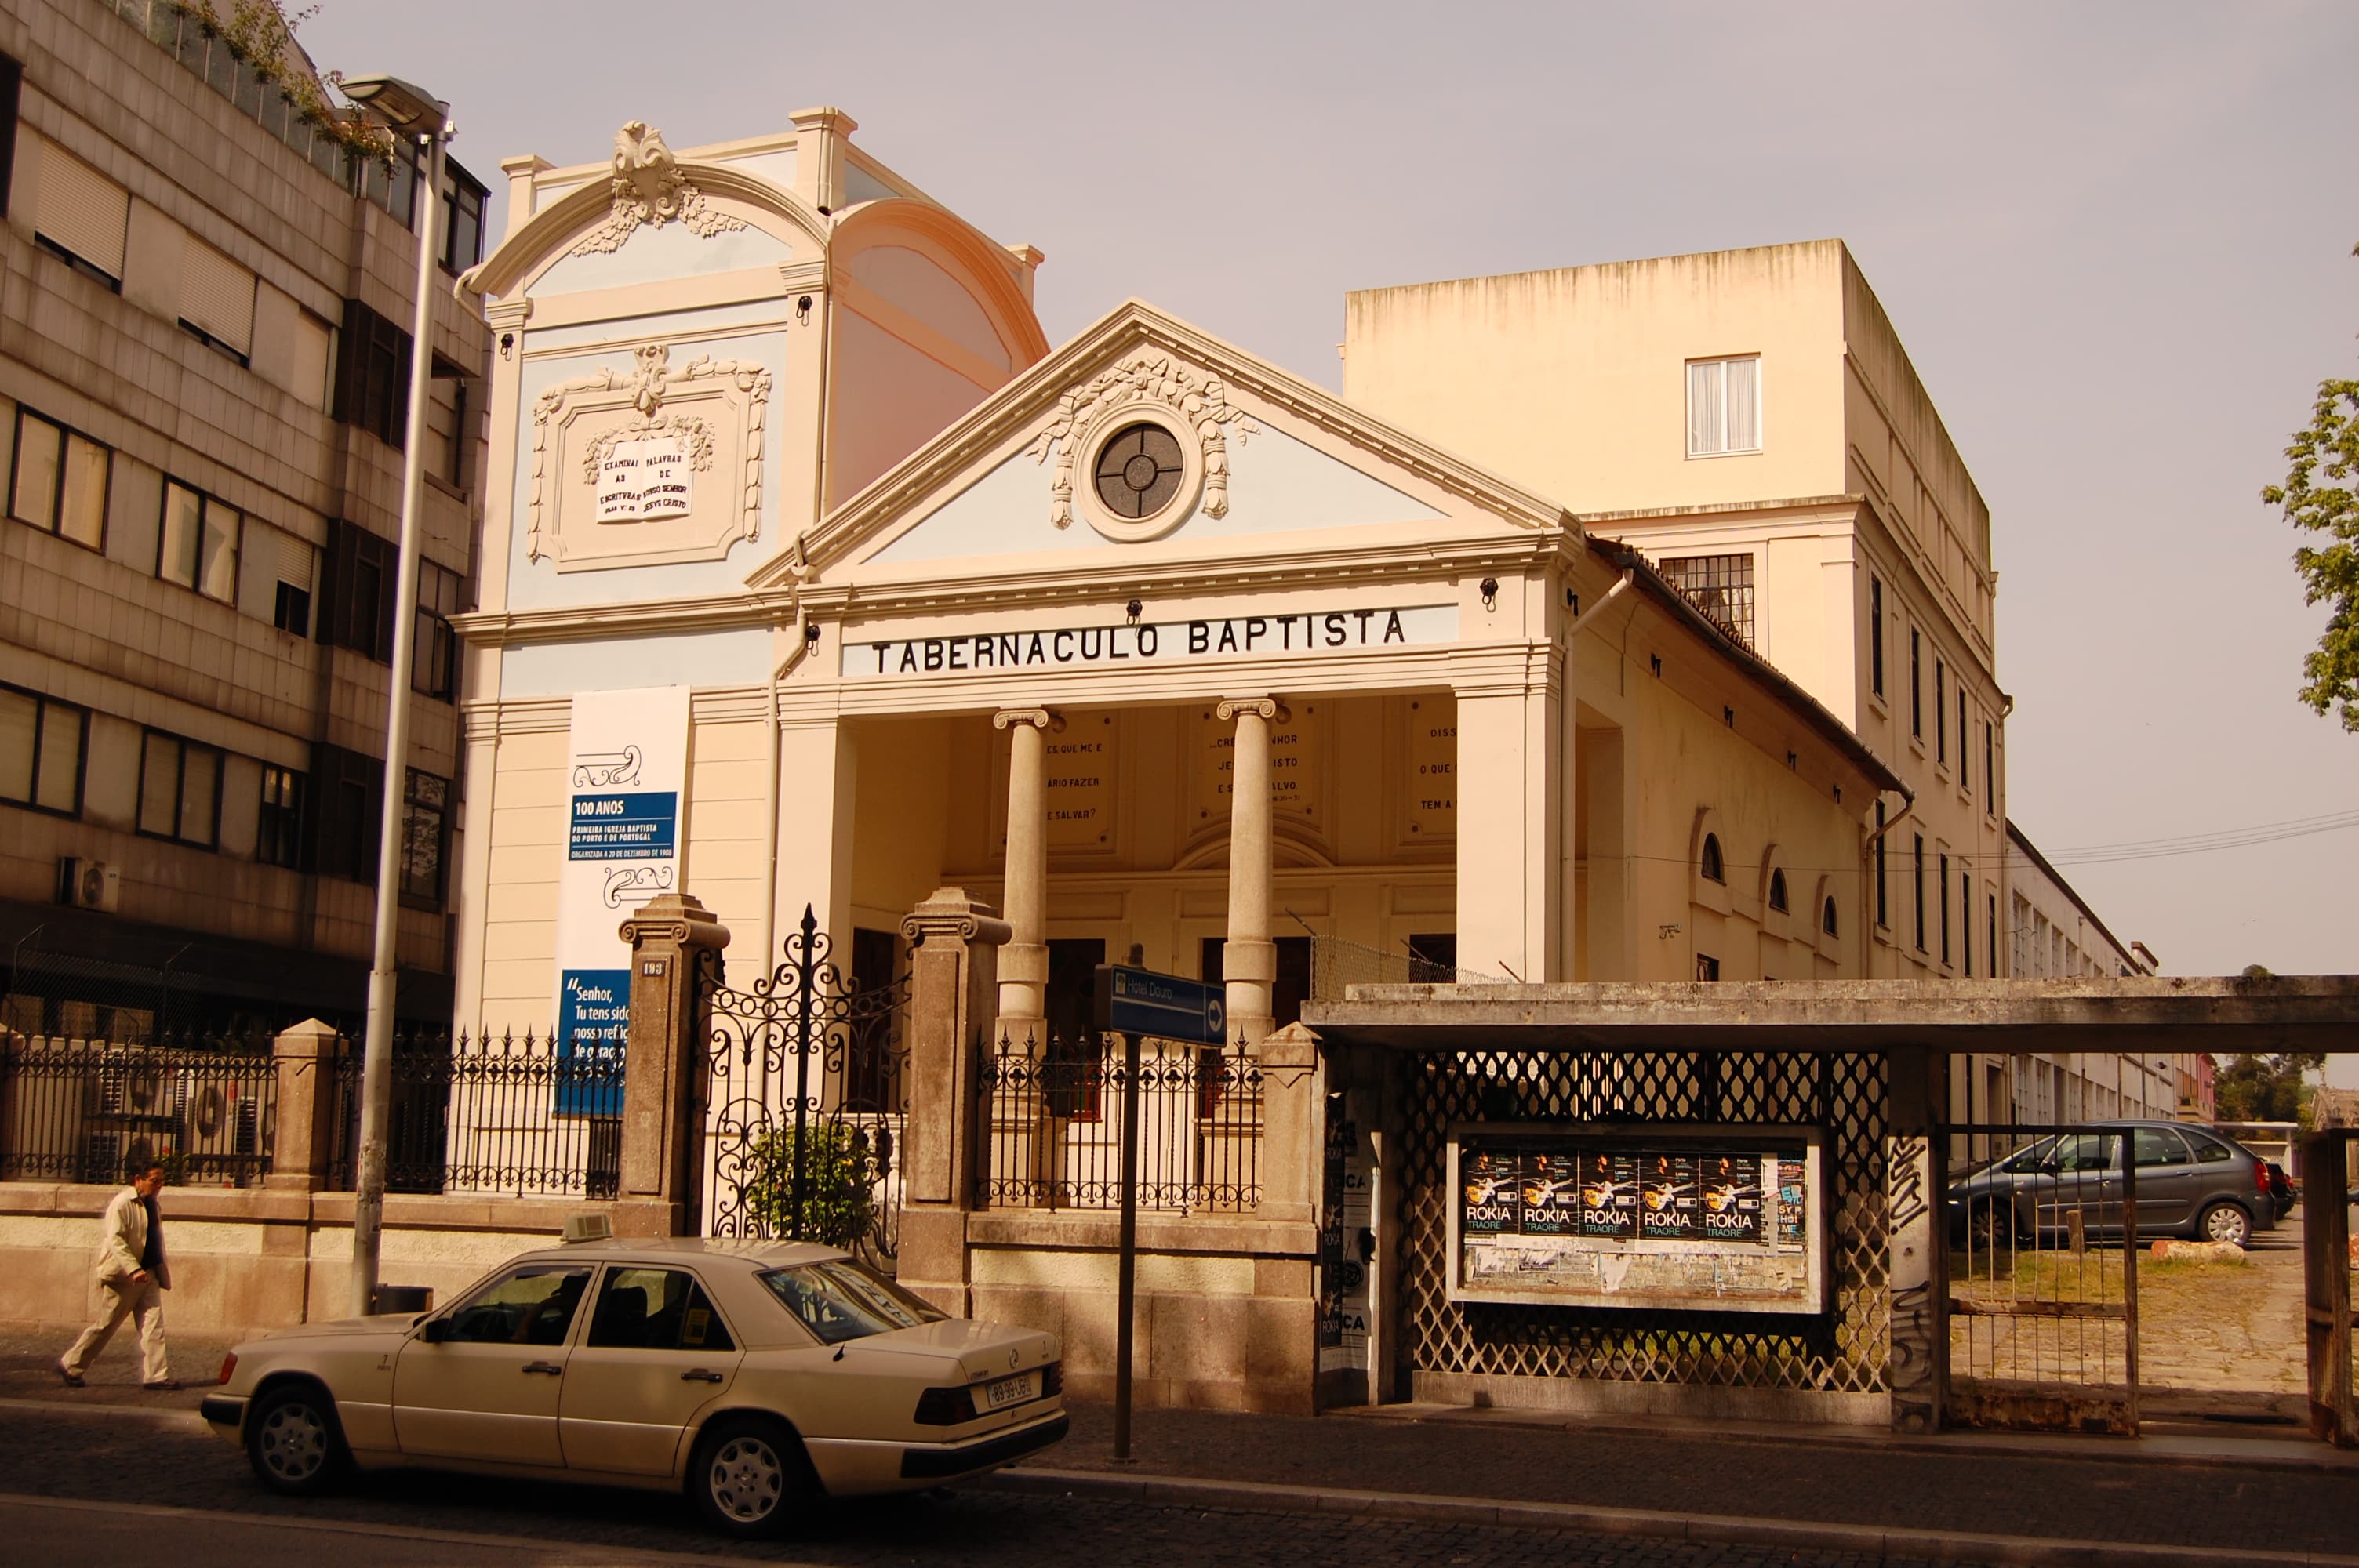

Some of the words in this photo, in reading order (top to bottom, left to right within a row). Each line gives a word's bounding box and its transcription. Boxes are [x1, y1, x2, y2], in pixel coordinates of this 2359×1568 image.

[604, 459, 638, 470] EXAMINAI
[646, 455, 682, 467] PALAVRAS
[616, 474, 625, 483] AS
[660, 470, 671, 478] DE
[663, 499, 687, 509] CRISTO
[872, 624, 1158, 673] TABERNACULO
[1189, 609, 1405, 654] BAPTISTA
[1060, 744, 1078, 753] QUE
[1081, 743, 1092, 753] ME
[1419, 764, 1427, 775] O
[1431, 764, 1450, 774] QUE
[1070, 777, 1100, 787] FAZER
[575, 801, 594, 815] 100
[595, 800, 624, 815] ANOS
[1421, 800, 1441, 810] TEM
[1445, 800, 1451, 808] A
[1056, 808, 1096, 820] SALVAR?
[572, 826, 603, 834] PRIMEIRA
[604, 825, 626, 833] IGREJA
[627, 824, 657, 833] BAPTISTA
[572, 834, 580, 843] DO
[582, 834, 602, 843] PORTO
[609, 833, 617, 842] DE
[619, 833, 651, 841] PORTUGAL
[644, 962, 662, 975] 193
[1128, 978, 1148, 996] Hotel
[1149, 982, 1172, 1000] Douro
[575, 1005, 587, 1020] Tu
[588, 1007, 609, 1020] tens
[1467, 1206, 1511, 1221] ROKIA
[1525, 1208, 1570, 1223] ROKIA
[1584, 1210, 1630, 1225] ROKIA
[1645, 1212, 1691, 1227] ROKIA
[1706, 1214, 1753, 1229] ROKIA
